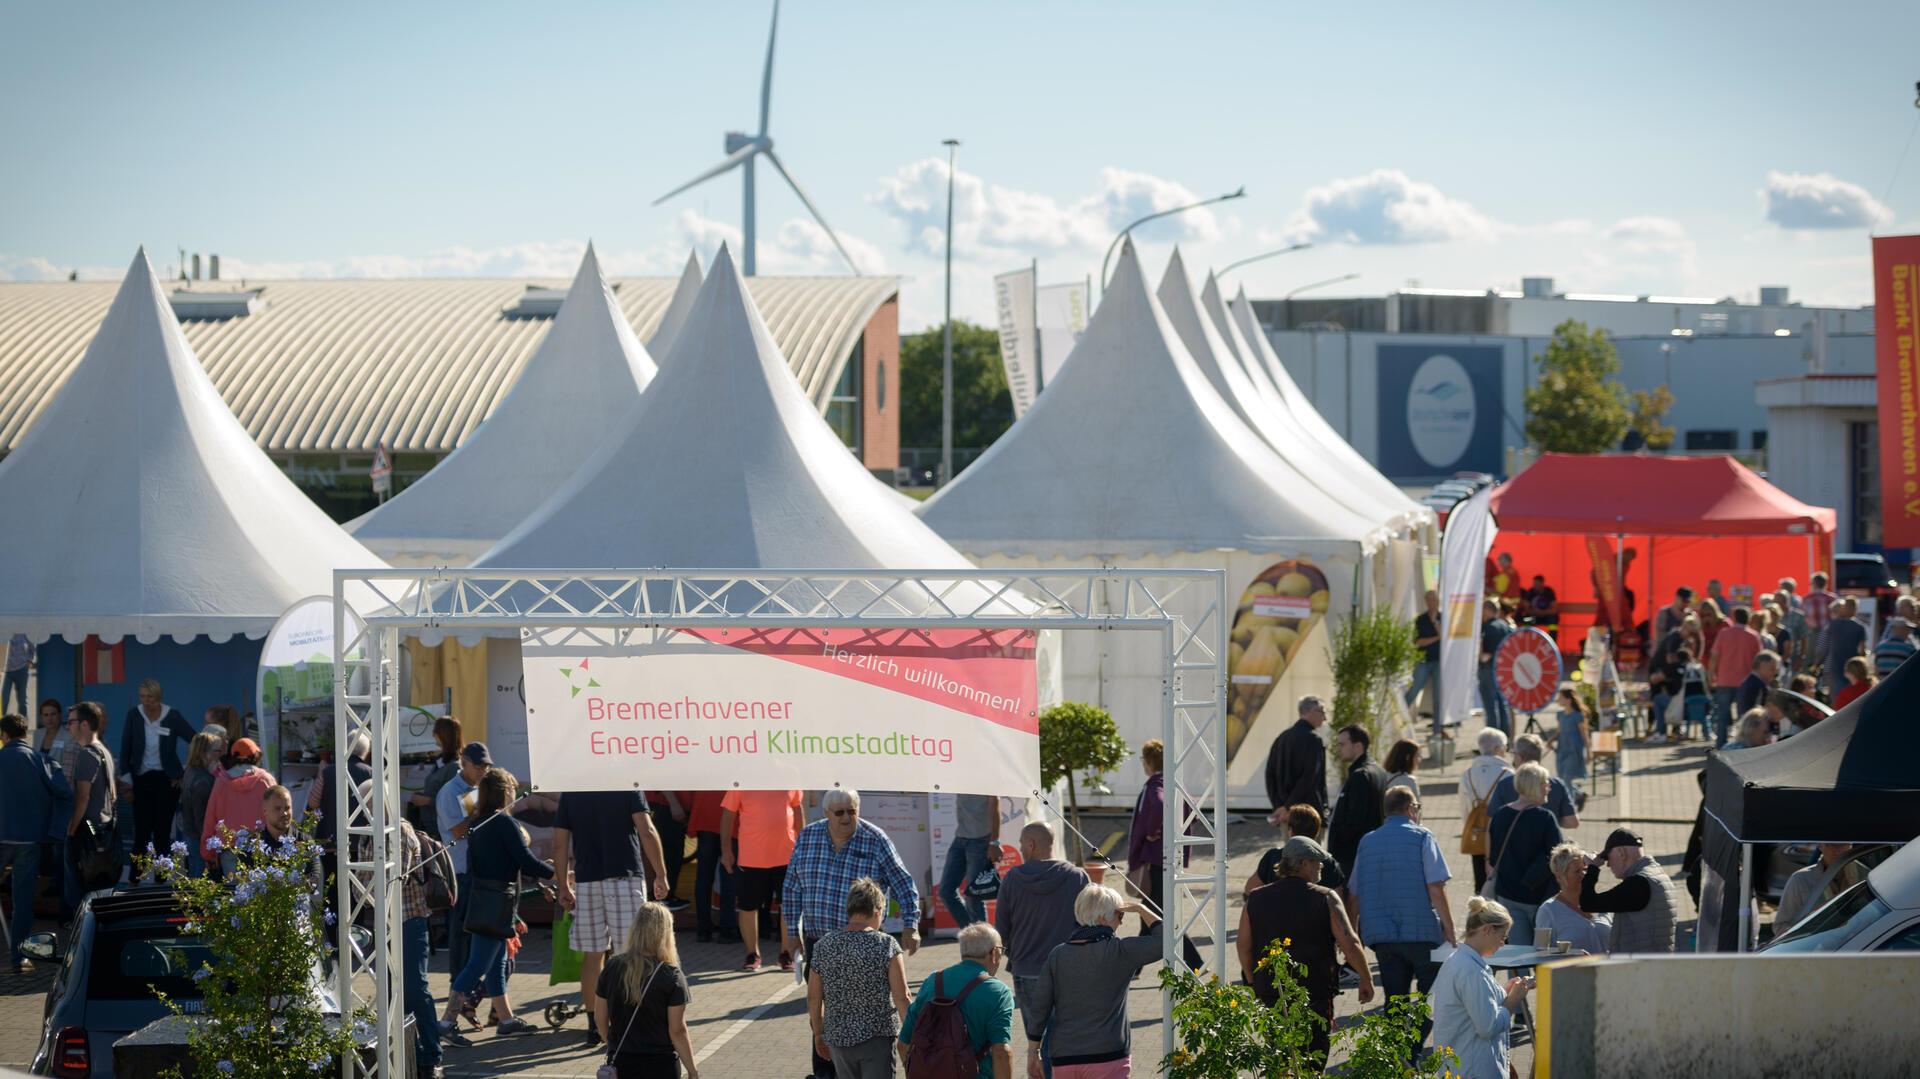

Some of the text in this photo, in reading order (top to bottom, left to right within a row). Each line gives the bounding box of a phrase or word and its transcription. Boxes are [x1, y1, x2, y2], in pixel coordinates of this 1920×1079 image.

[1892, 263, 1920, 518] Bezirk Bremerhaven e.V.
[822, 641, 1021, 714] Herzlich willkommen!
[587, 696, 793, 721] Bremerhavener
[590, 729, 953, 763] Energie- und Klimastadttag
